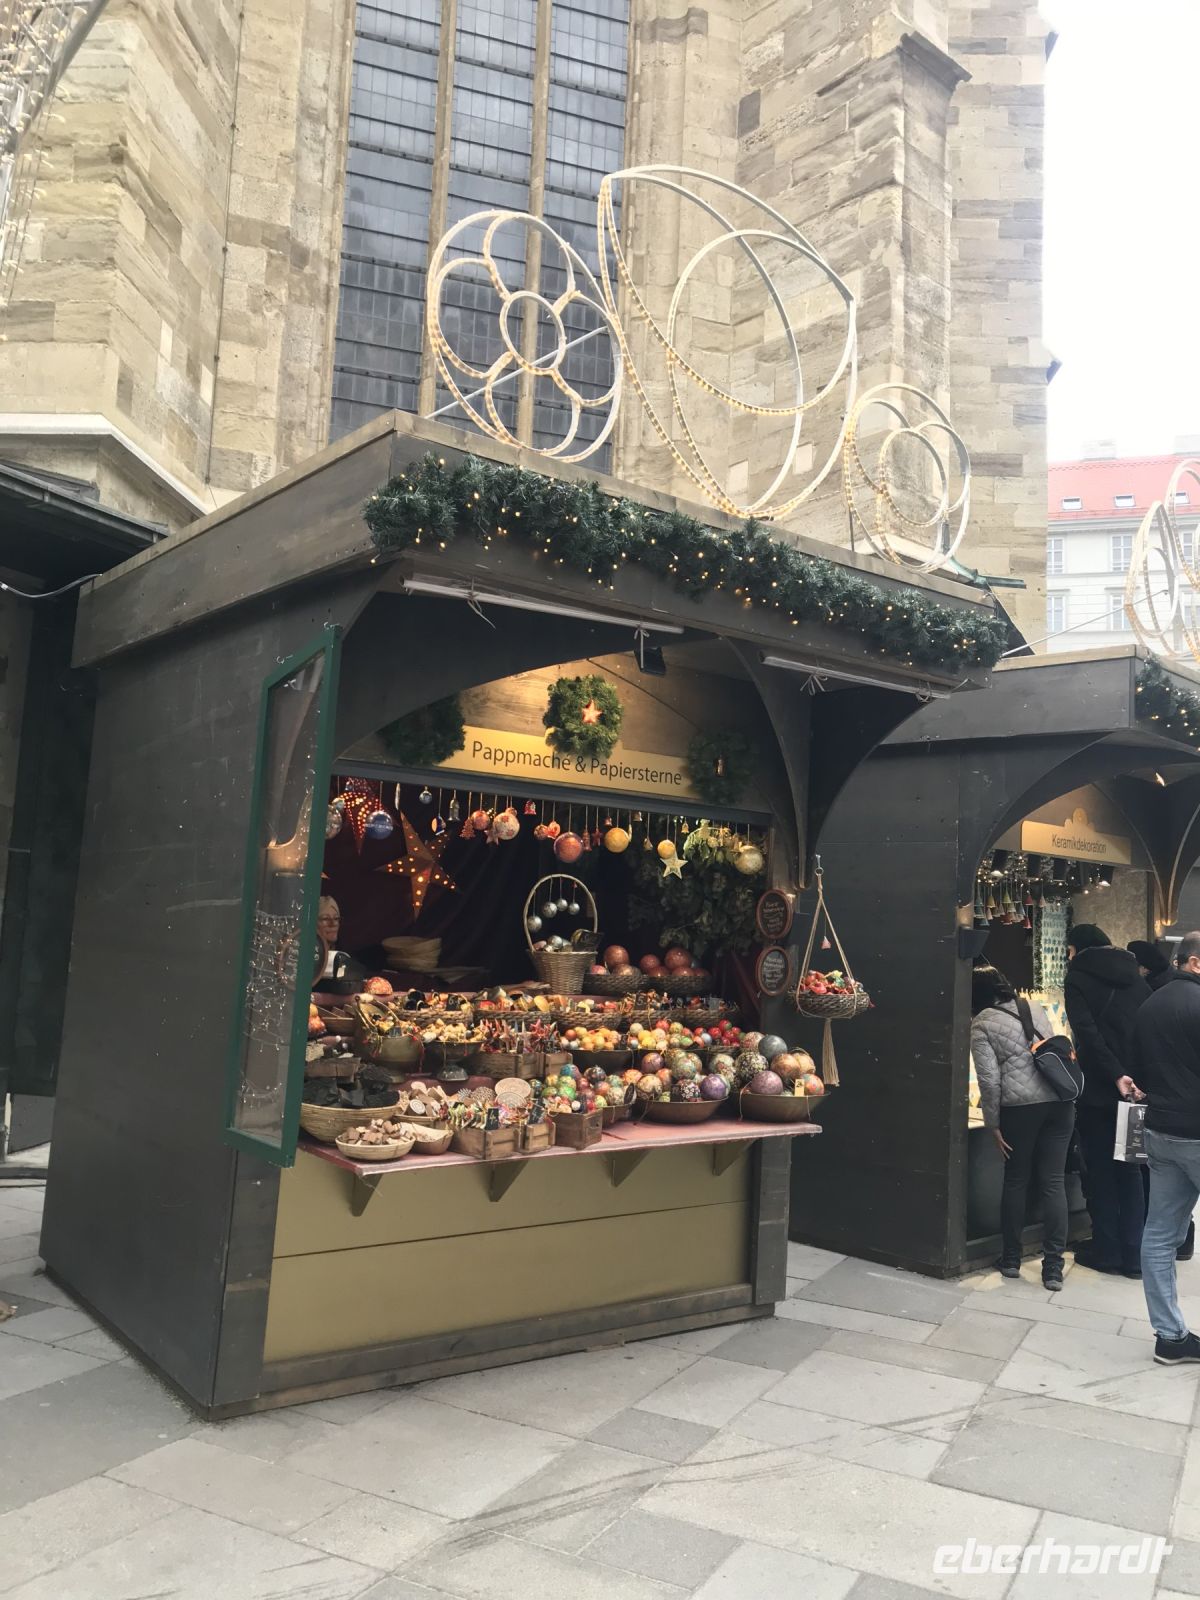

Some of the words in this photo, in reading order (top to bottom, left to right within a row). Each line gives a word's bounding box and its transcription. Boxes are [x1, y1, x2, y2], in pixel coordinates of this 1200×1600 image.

[472, 740, 571, 771] Pappmaché
[575, 755, 587, 773] &
[590, 757, 682, 786] Papiersterne
[1052, 833, 1107, 854] Keramikdekoration
